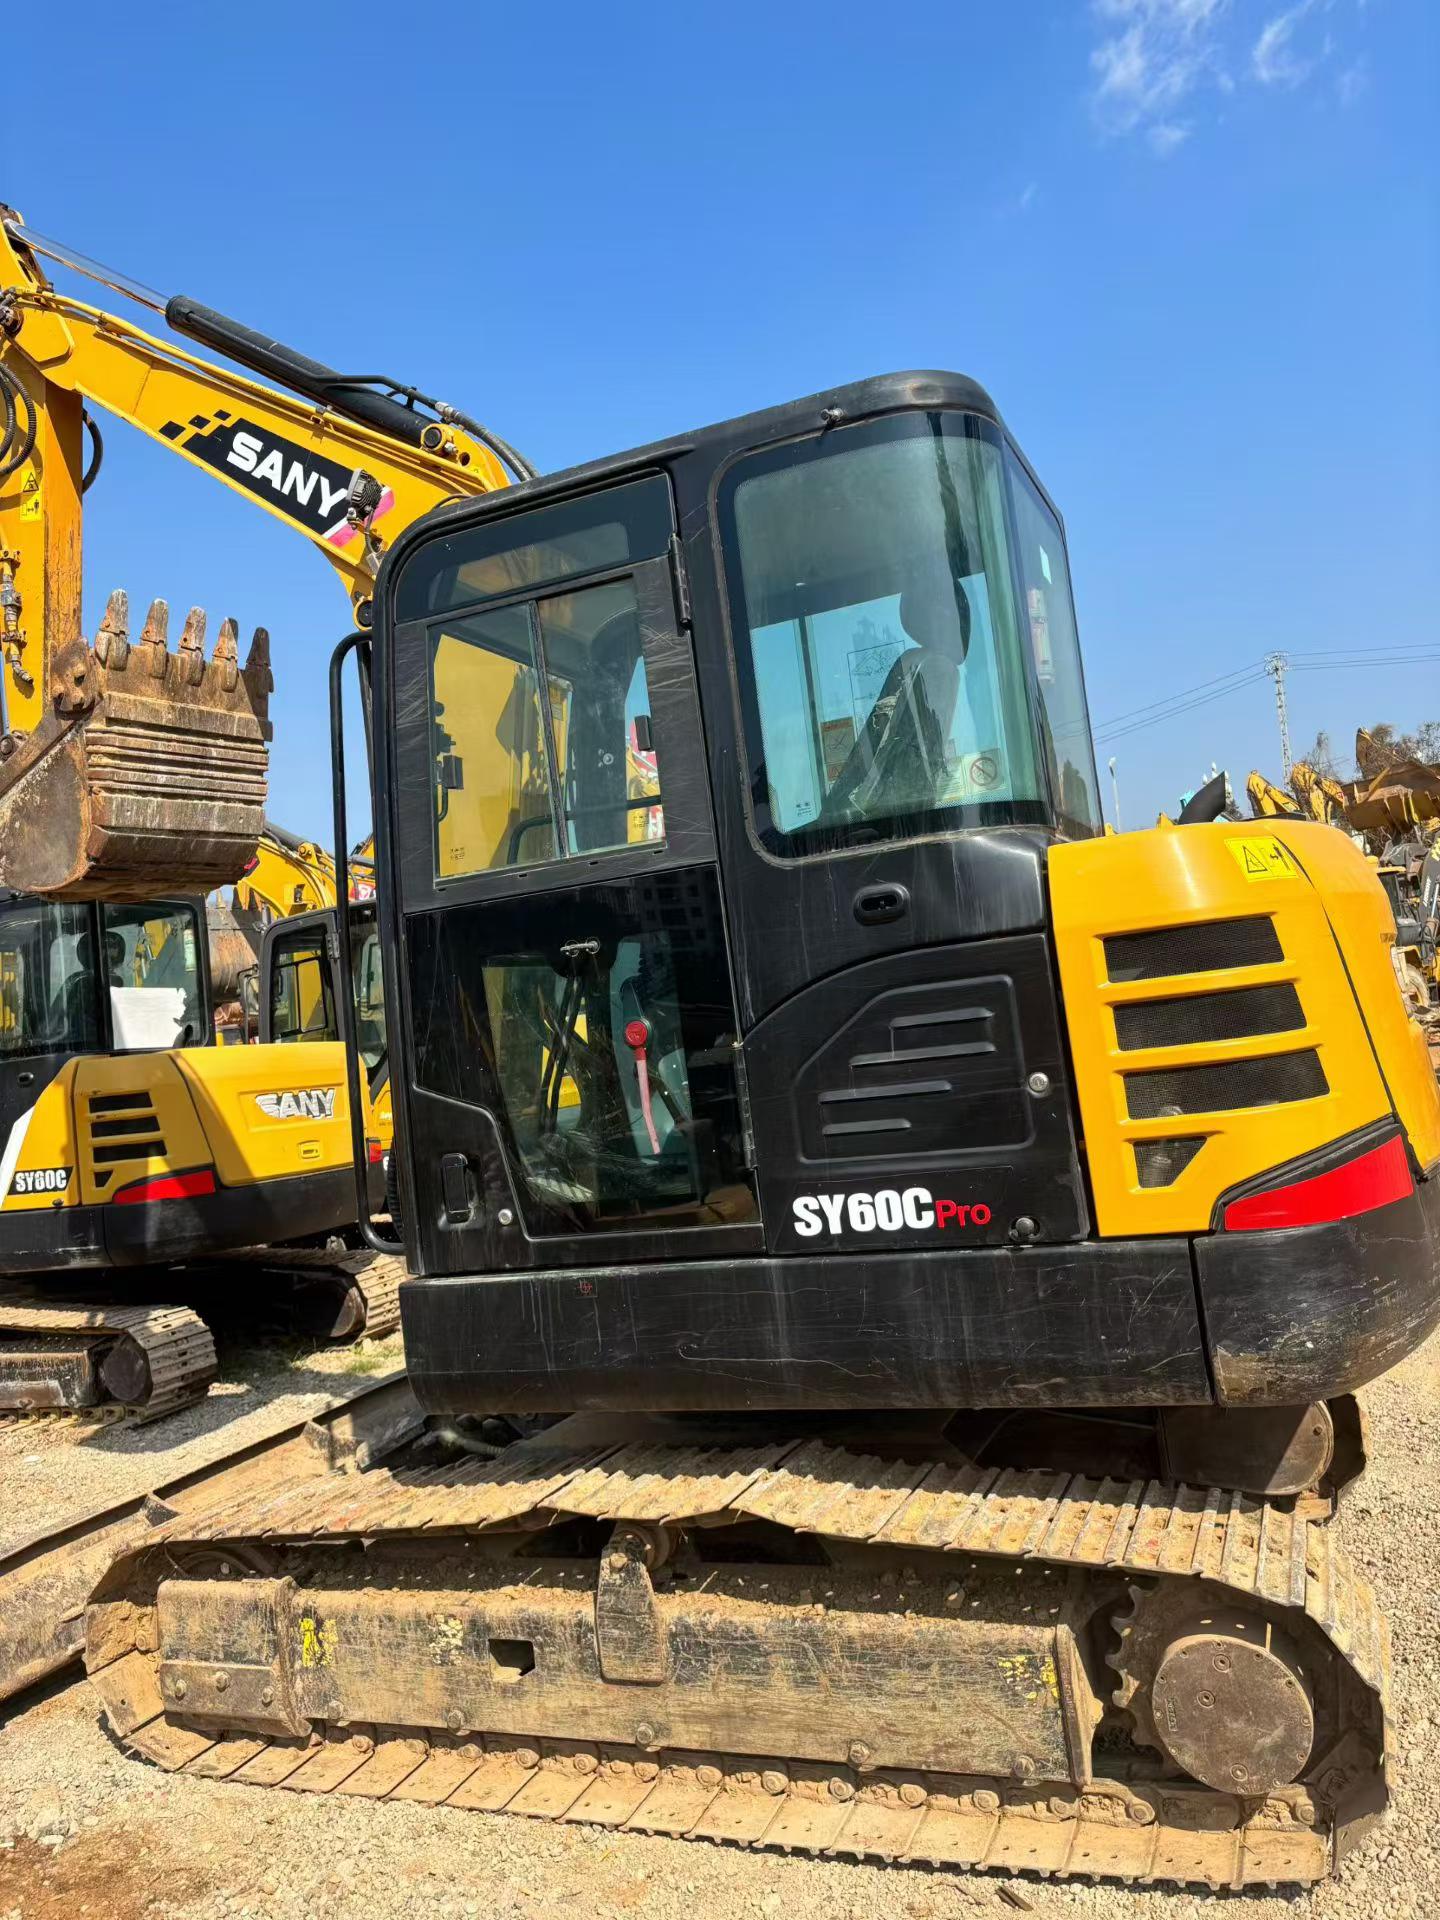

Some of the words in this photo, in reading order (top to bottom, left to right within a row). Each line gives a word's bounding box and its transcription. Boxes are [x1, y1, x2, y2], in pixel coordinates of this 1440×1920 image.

[227, 431, 348, 518] SANY
[255, 1088, 335, 1119] SANY
[15, 1169, 67, 1192] SY60C
[792, 1187, 935, 1237] SY60C
[935, 1200, 991, 1230] Pro
